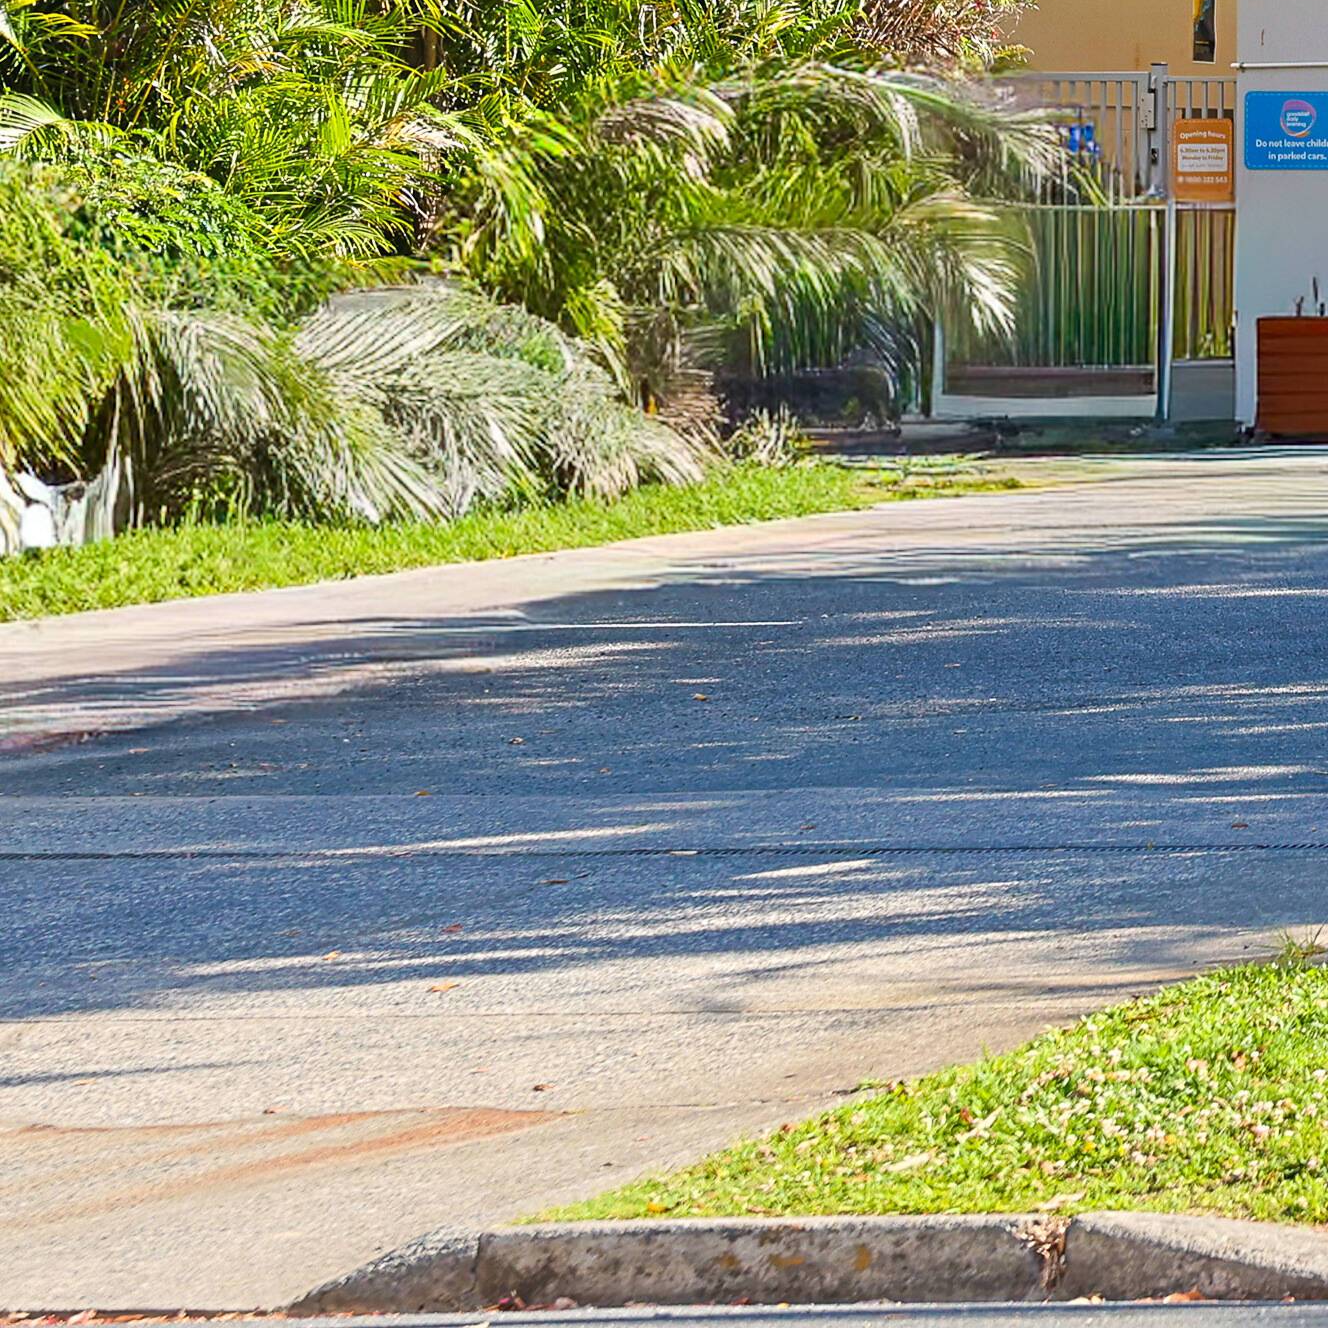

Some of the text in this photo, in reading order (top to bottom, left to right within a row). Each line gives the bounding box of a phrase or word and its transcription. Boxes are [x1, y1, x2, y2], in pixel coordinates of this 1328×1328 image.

[1255, 139, 1267, 148] Do
[1268, 139, 1282, 148] not
[1283, 138, 1305, 148] leave
[1268, 151, 1276, 160] in
[1277, 151, 1306, 162] parked
